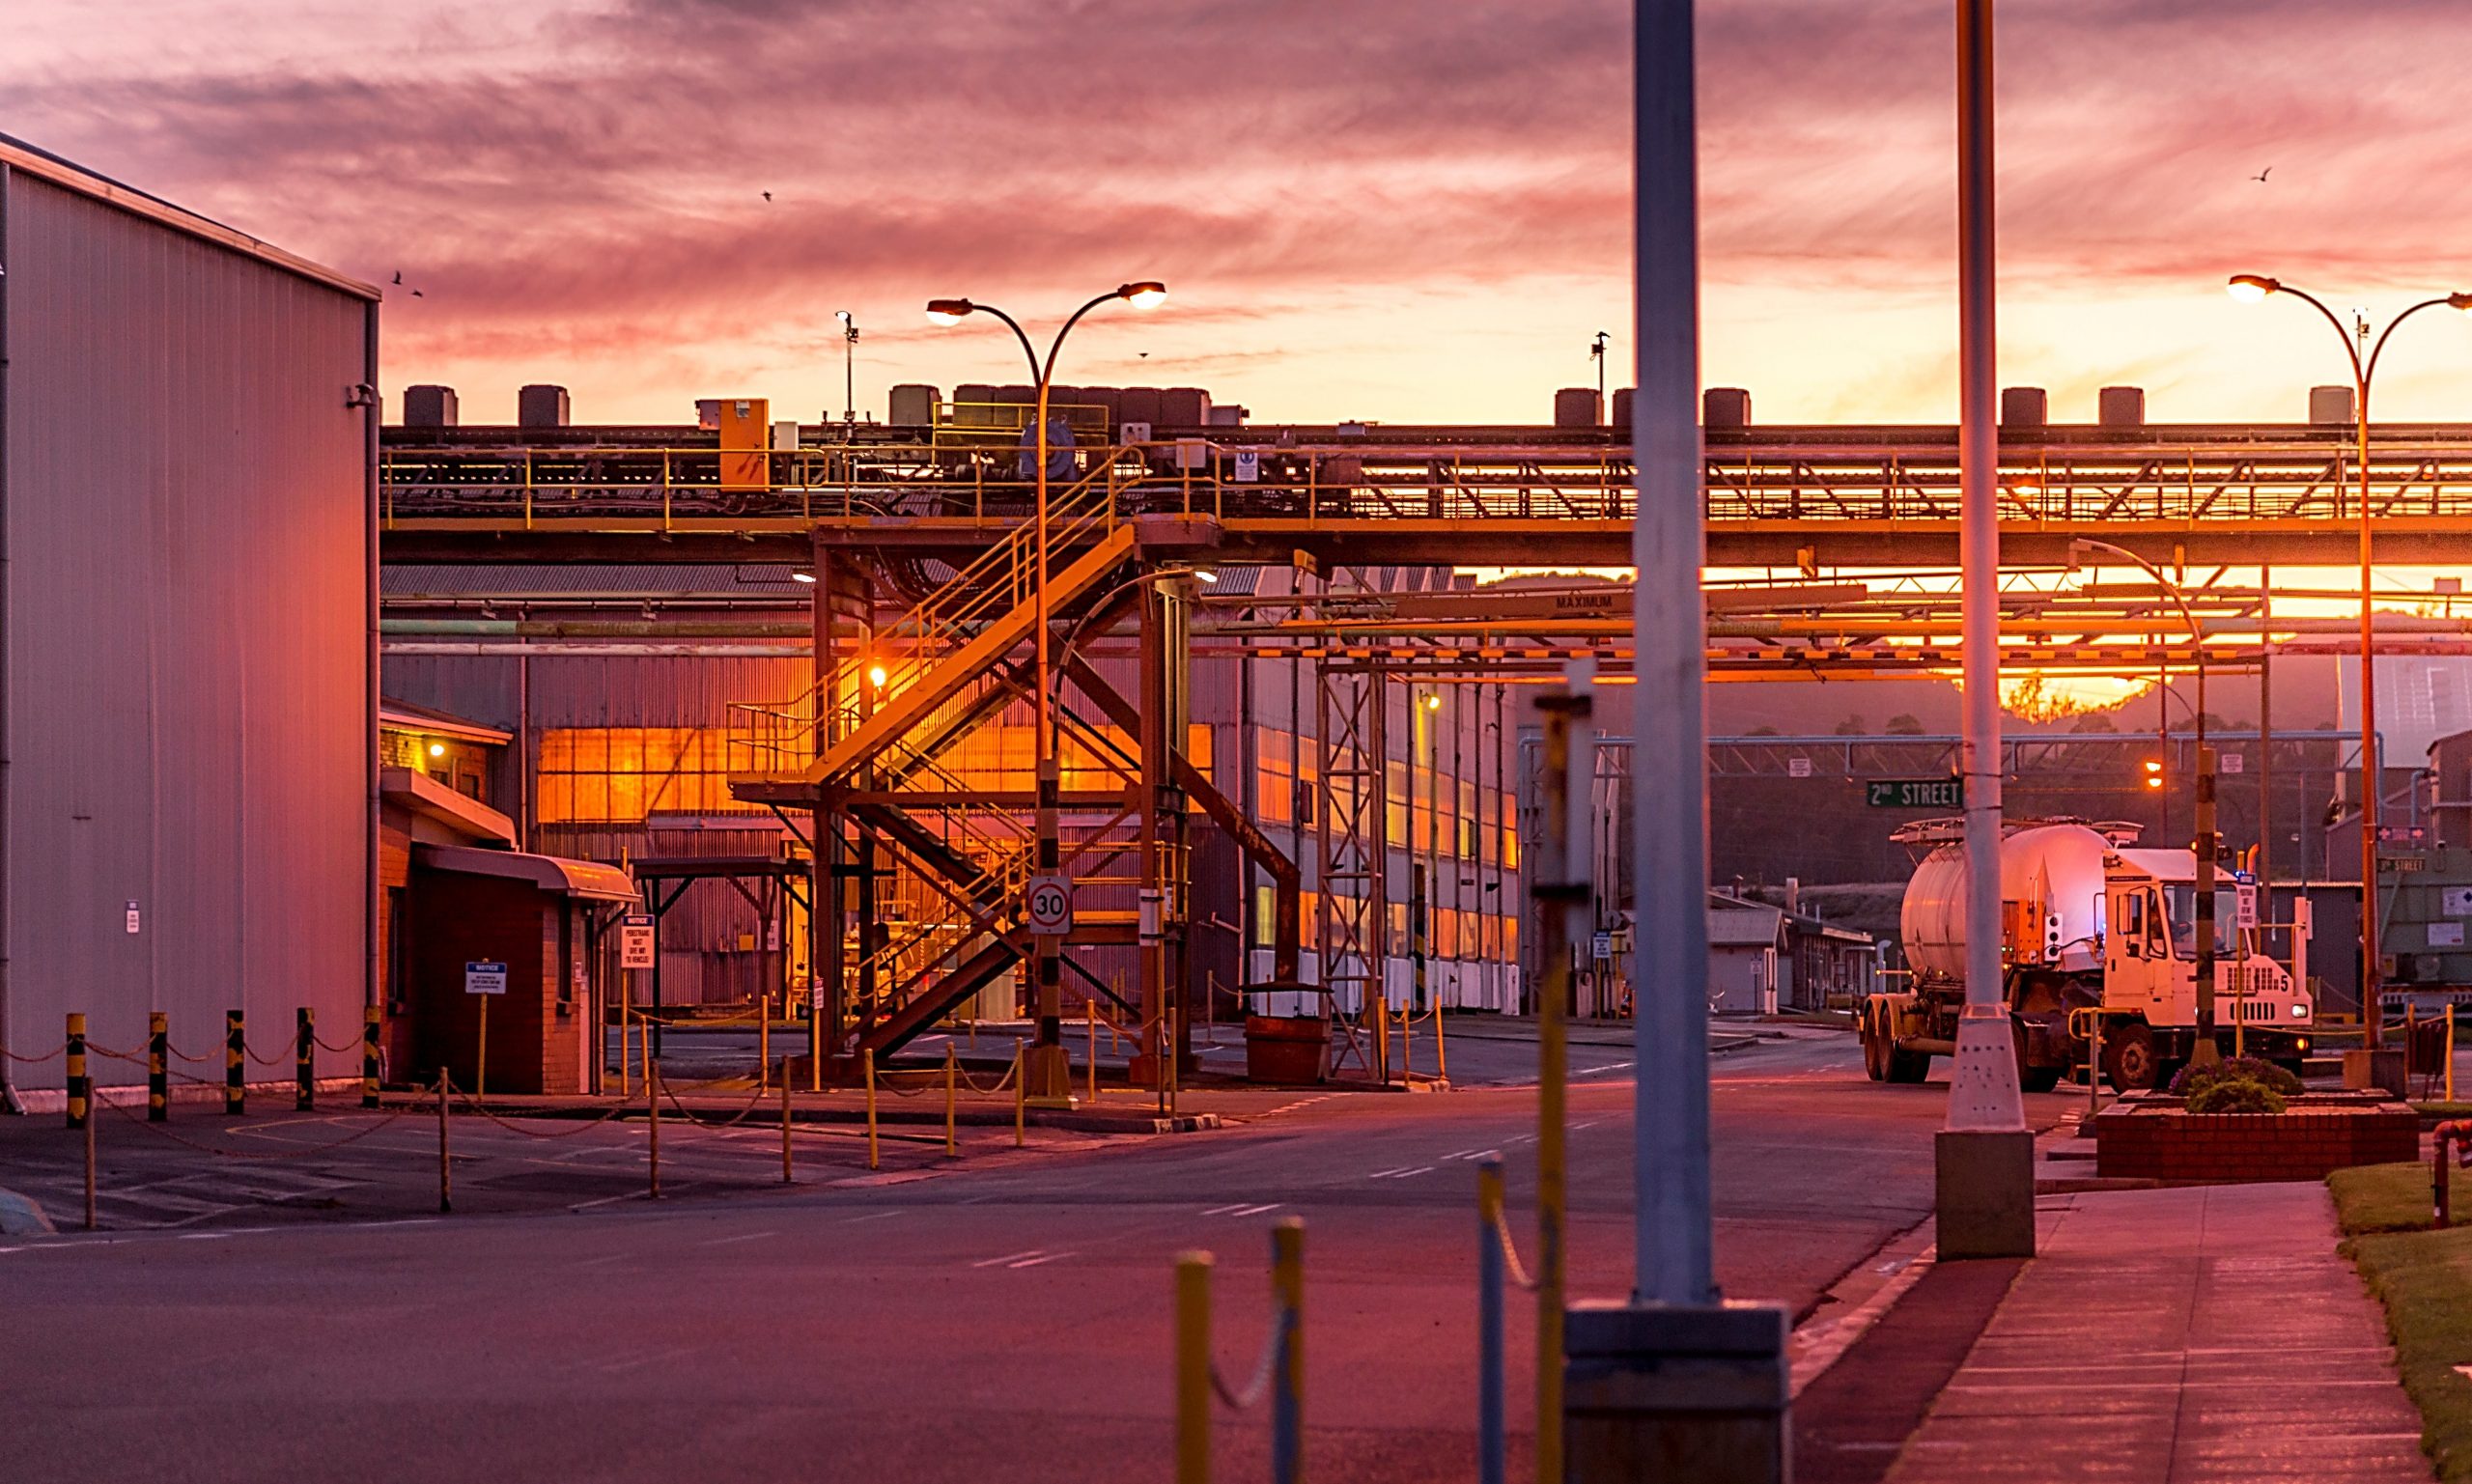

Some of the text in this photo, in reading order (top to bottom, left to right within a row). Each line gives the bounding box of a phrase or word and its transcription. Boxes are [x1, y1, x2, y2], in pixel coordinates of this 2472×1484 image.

[1557, 595, 1613, 608] MAXIMUM
[1901, 783, 1959, 804] STREET
[1035, 894, 1063, 915] 30
[2281, 975, 2289, 993] 5
